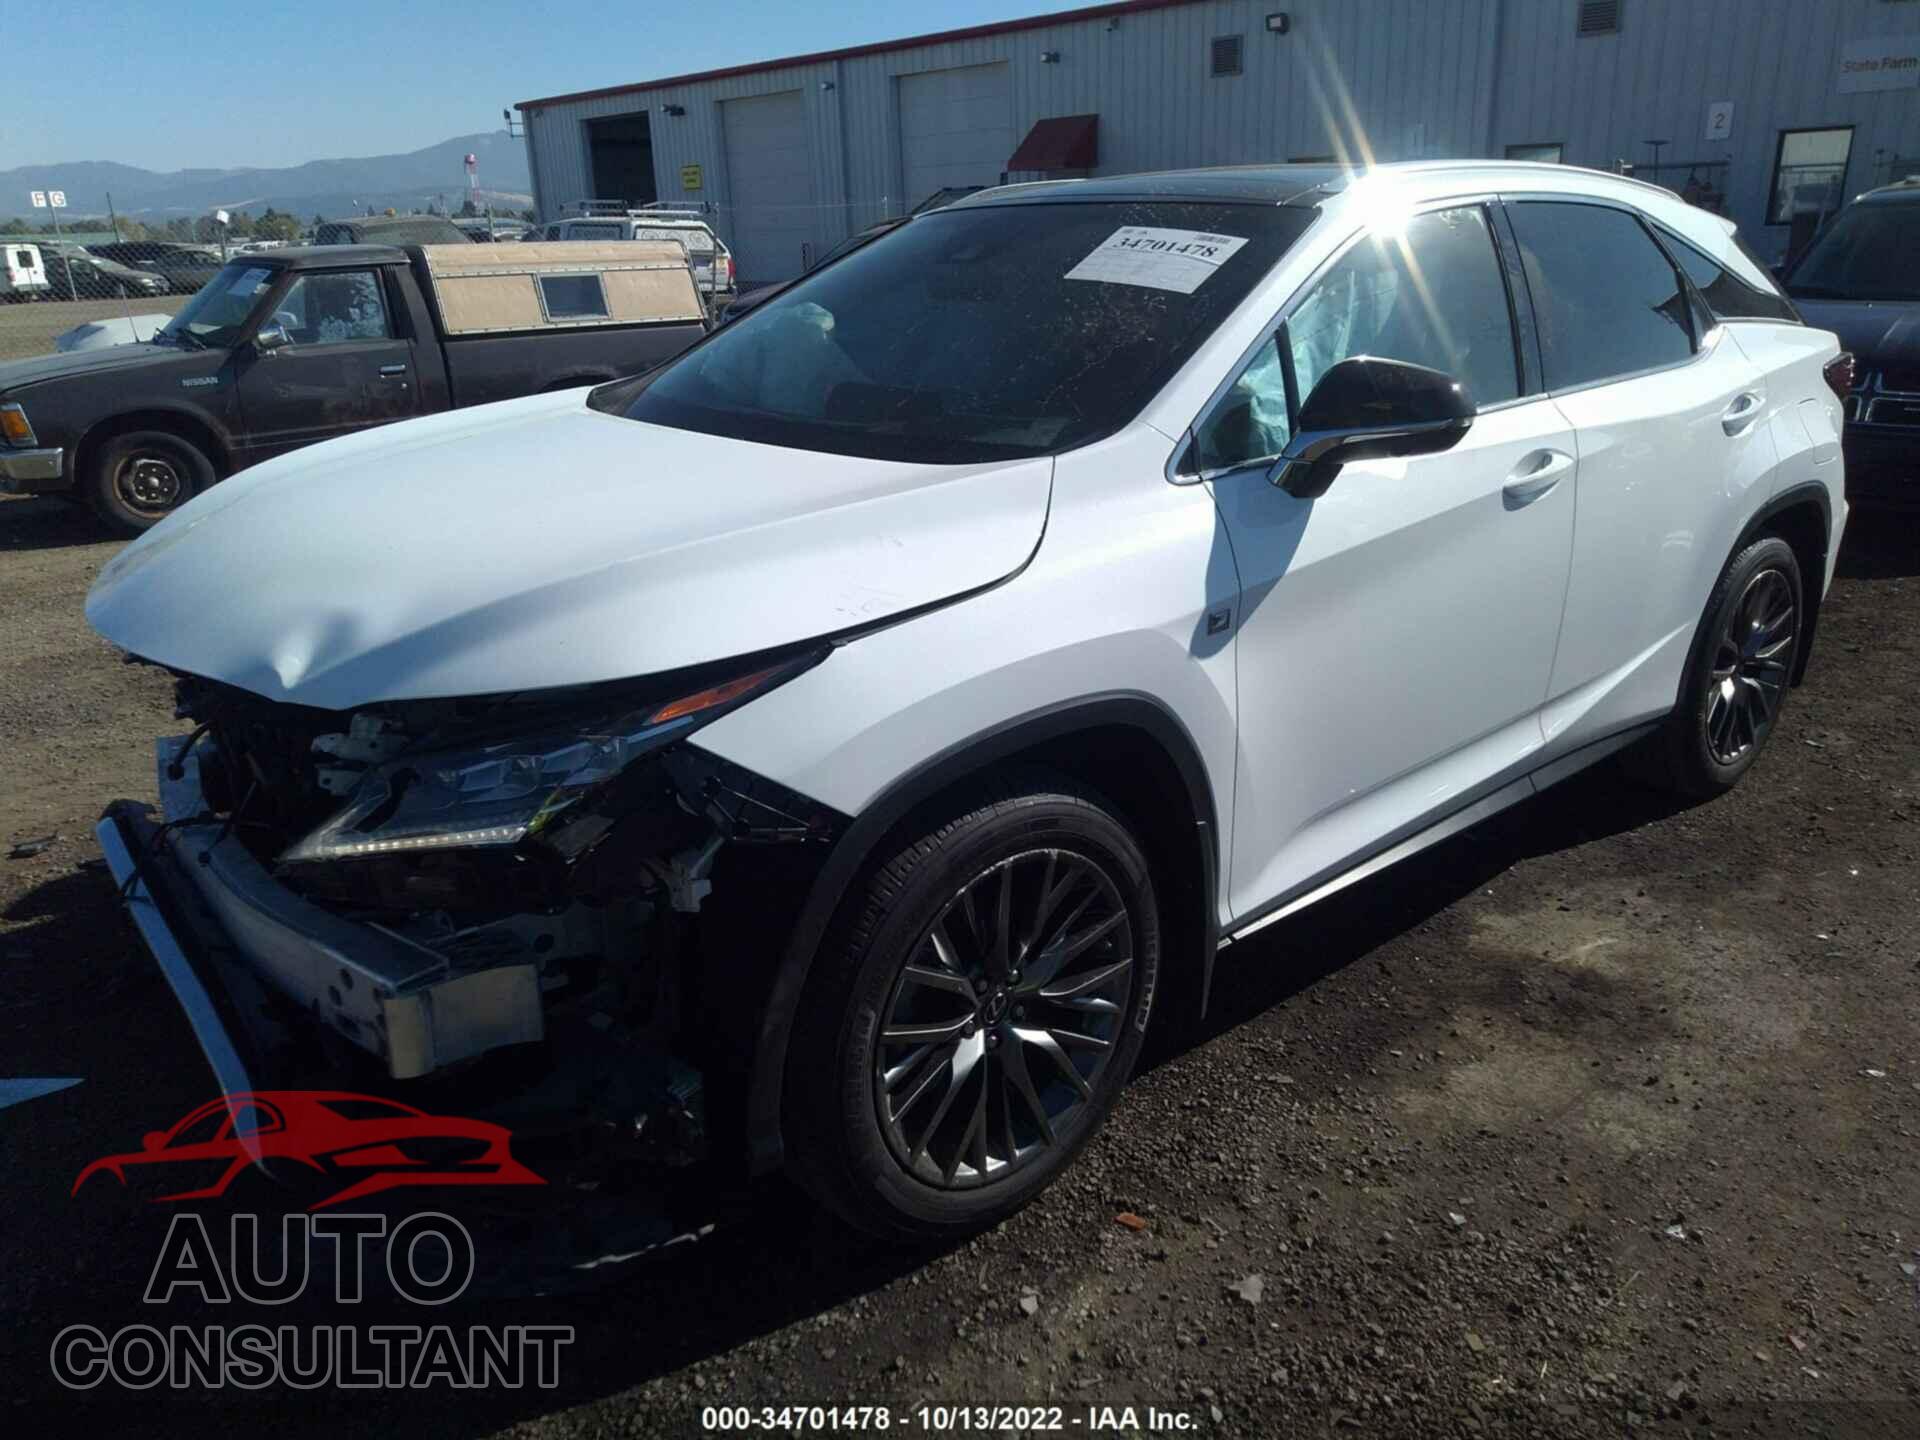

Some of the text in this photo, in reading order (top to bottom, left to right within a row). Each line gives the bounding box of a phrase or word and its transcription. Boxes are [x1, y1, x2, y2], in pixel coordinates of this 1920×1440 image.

[1714, 112, 1725, 129] 2
[51, 191, 65, 206] G
[1112, 237, 1219, 257] 34701478
[182, 376, 218, 387] NISSAN
